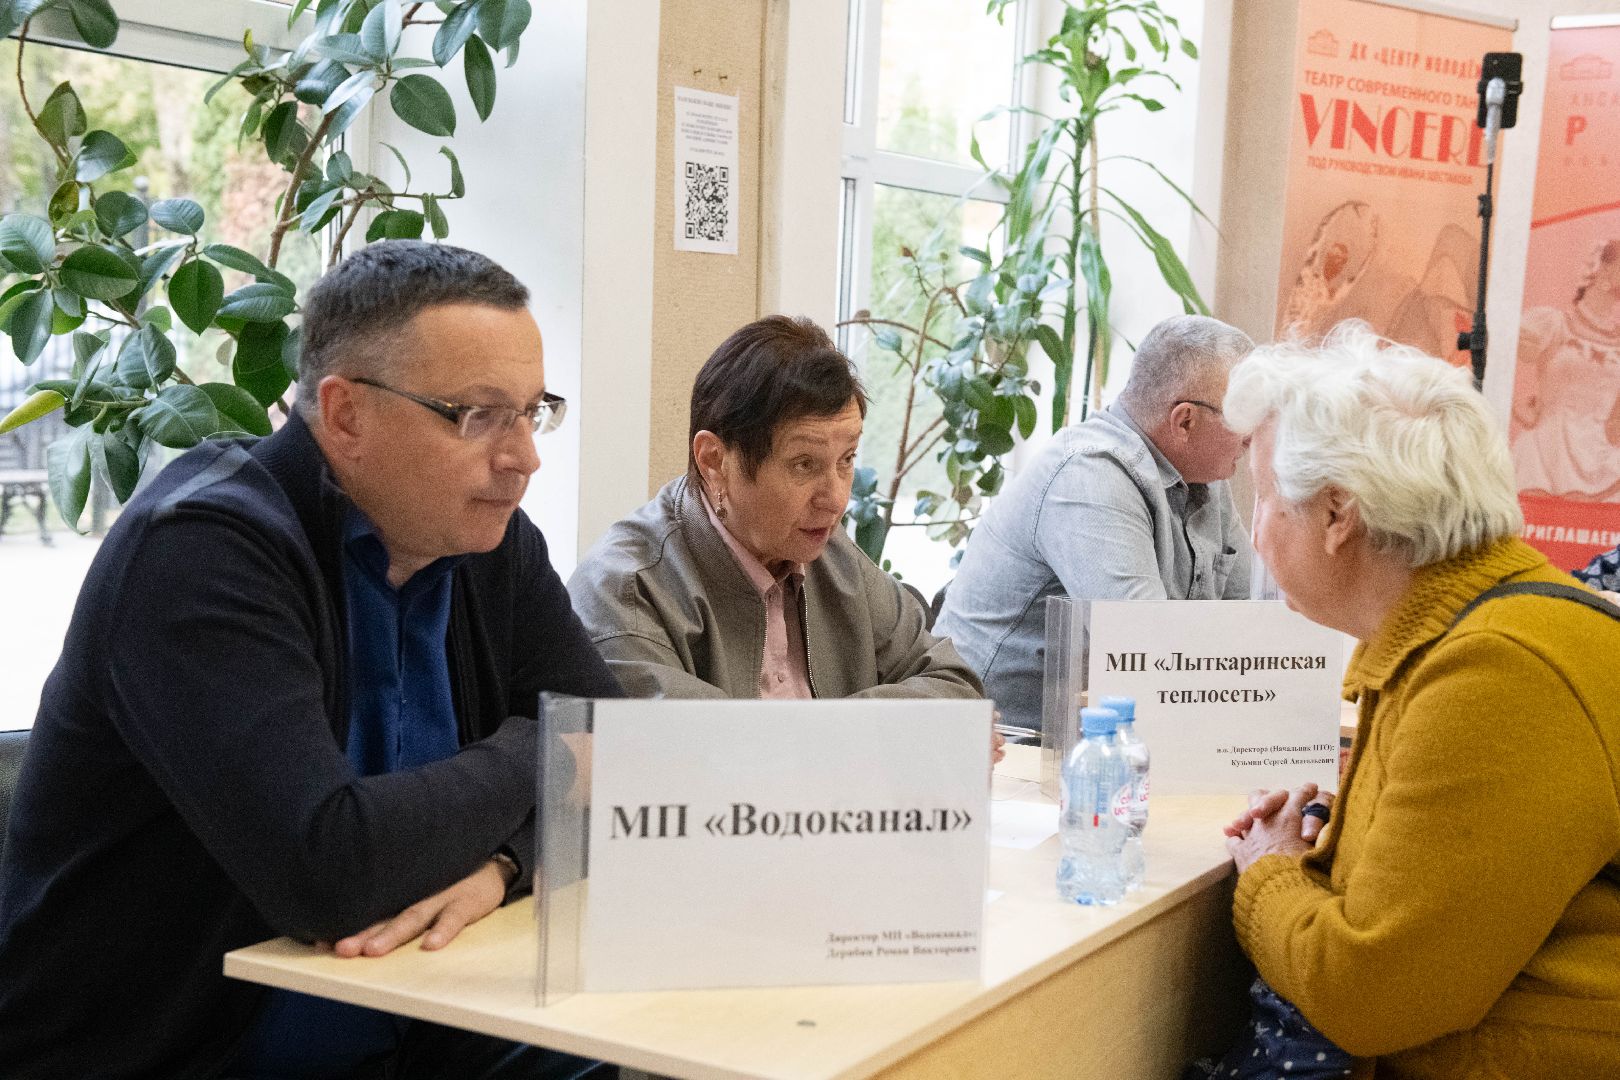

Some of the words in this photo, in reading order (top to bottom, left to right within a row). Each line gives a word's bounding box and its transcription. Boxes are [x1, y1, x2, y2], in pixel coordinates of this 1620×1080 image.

[1304, 70, 1344, 89] ТЕАТР
[1347, 77, 1452, 106] СОВРЕМЕННОГО
[1456, 94, 1478, 108] ТАН
[1521, 524, 1620, 546] РИГЛАШАЕМ
[1105, 652, 1147, 672] МП
[1153, 651, 1326, 676] «Лыткаринская
[1157, 688, 1276, 704] теплосеть»
[1230, 745, 1269, 755] Директора
[1270, 744, 1311, 754] (Начальник
[1231, 758, 1262, 768] Кузьмин
[1263, 757, 1288, 767] Сергей
[1289, 757, 1334, 766] Анатольевич
[610, 803, 689, 840] МП
[704, 802, 973, 840] «Водоканал»
[827, 931, 879, 944] Директор
